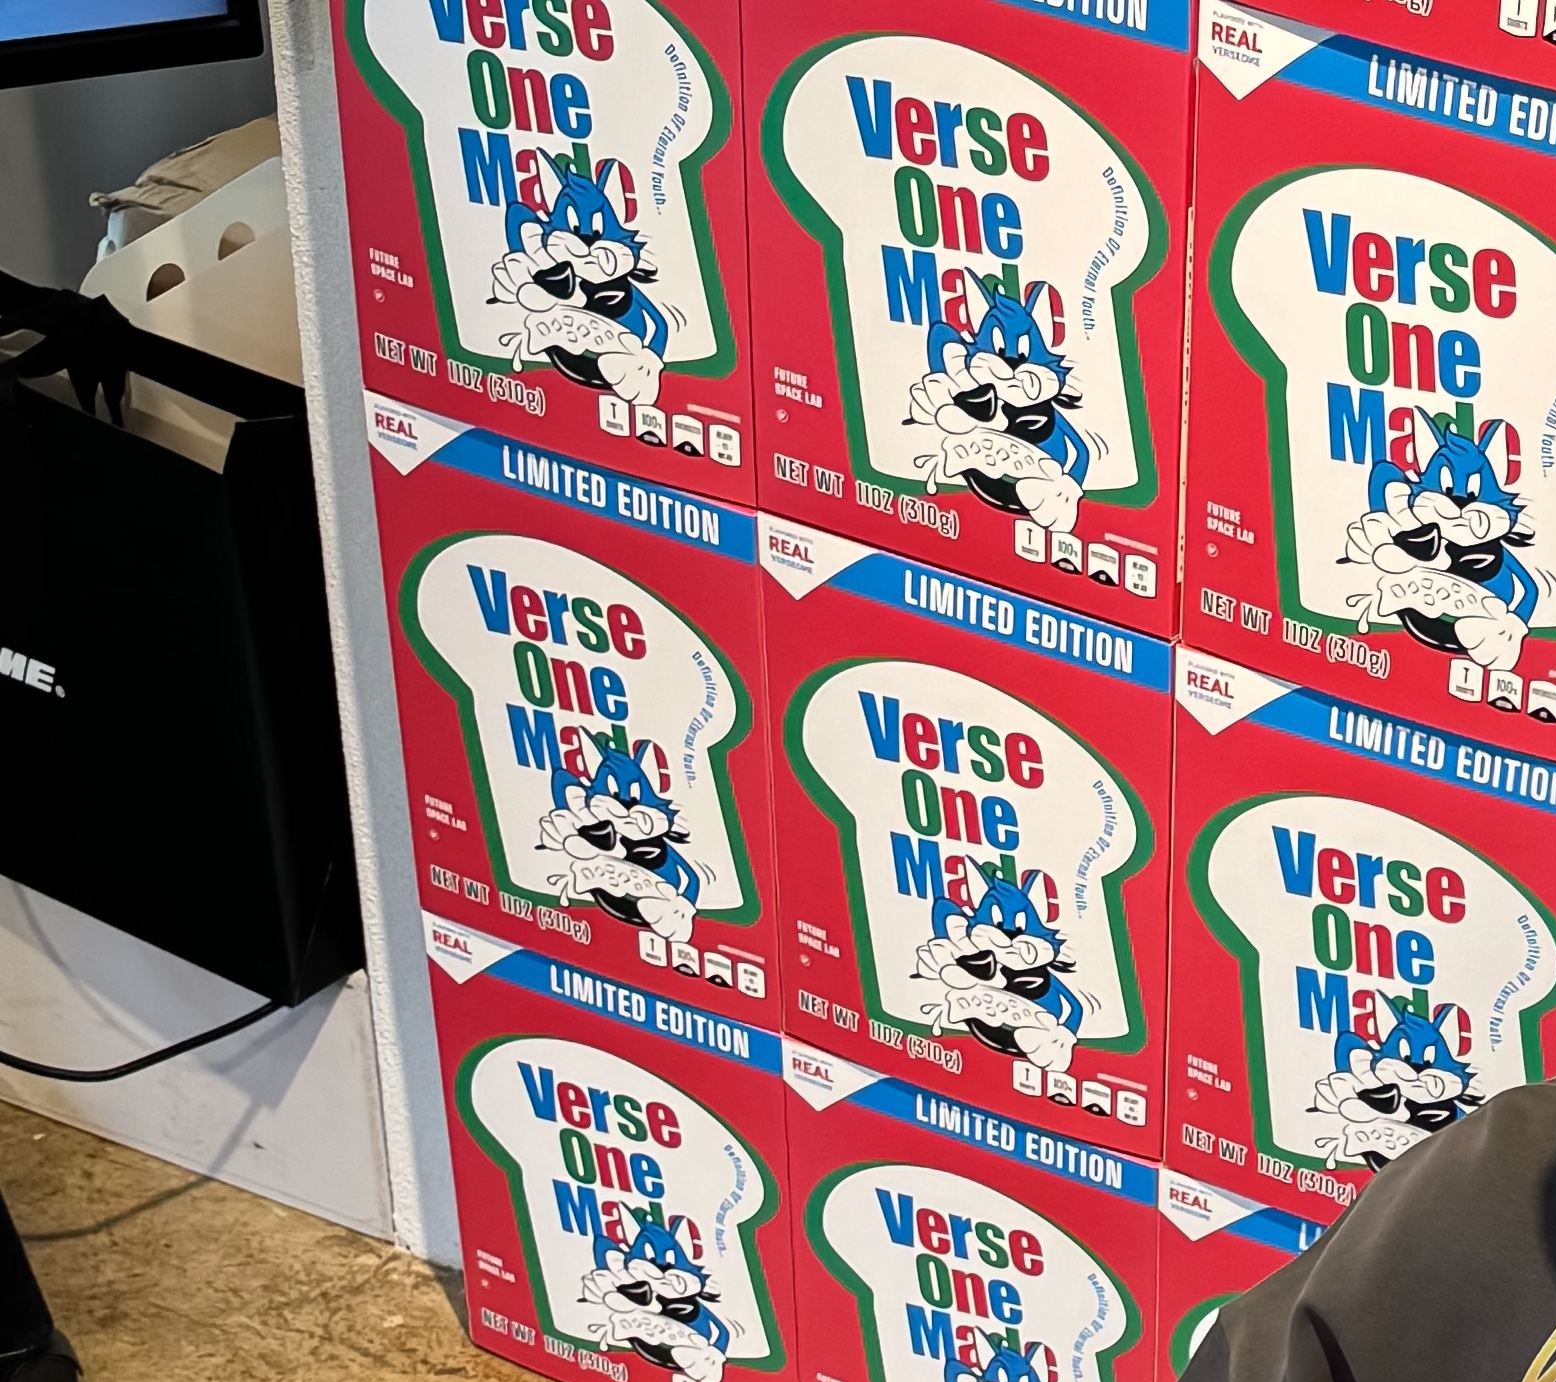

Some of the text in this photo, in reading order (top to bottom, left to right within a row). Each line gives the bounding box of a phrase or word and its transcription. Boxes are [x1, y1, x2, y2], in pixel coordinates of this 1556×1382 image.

[428, 0, 612, 60] Verse
[1211, 20, 1263, 54] REAL
[467, 50, 591, 138] One
[846, 73, 1049, 181] Verse
[1368, 53, 1498, 129] LIMITED
[894, 165, 1023, 258] One
[1303, 209, 1516, 317] Verse
[375, 333, 404, 364] NET
[409, 345, 436, 375] WT
[1346, 302, 1482, 397] One
[374, 411, 417, 439] REAL
[501, 444, 720, 545] LIMITED EDITION
[775, 453, 807, 485] NET
[815, 466, 843, 497] WT
[769, 534, 814, 564] REAL
[466, 564, 645, 658] Verse
[904, 568, 1132, 674] LIMITED EDITION
[1202, 588, 1235, 621] NET
[1242, 603, 1271, 634] WT
[513, 641, 628, 721] One
[1187, 669, 1234, 699] REAL
[858, 690, 1044, 788] Verse
[1328, 705, 1446, 772] LIMITED
[901, 768, 1019, 850] One
[1272, 825, 1466, 922] Verse
[432, 928, 472, 954] REAL
[1312, 903, 1435, 984] One
[549, 962, 749, 1059] LIMITED EDITION
[517, 1061, 680, 1148] Verse
[792, 1054, 833, 1081] REAL
[559, 1127, 663, 1197] One
[915, 1091, 1121, 1189] LIMITED EDITION
[875, 1186, 1044, 1276] Verse
[915, 1252, 1023, 1324] One
